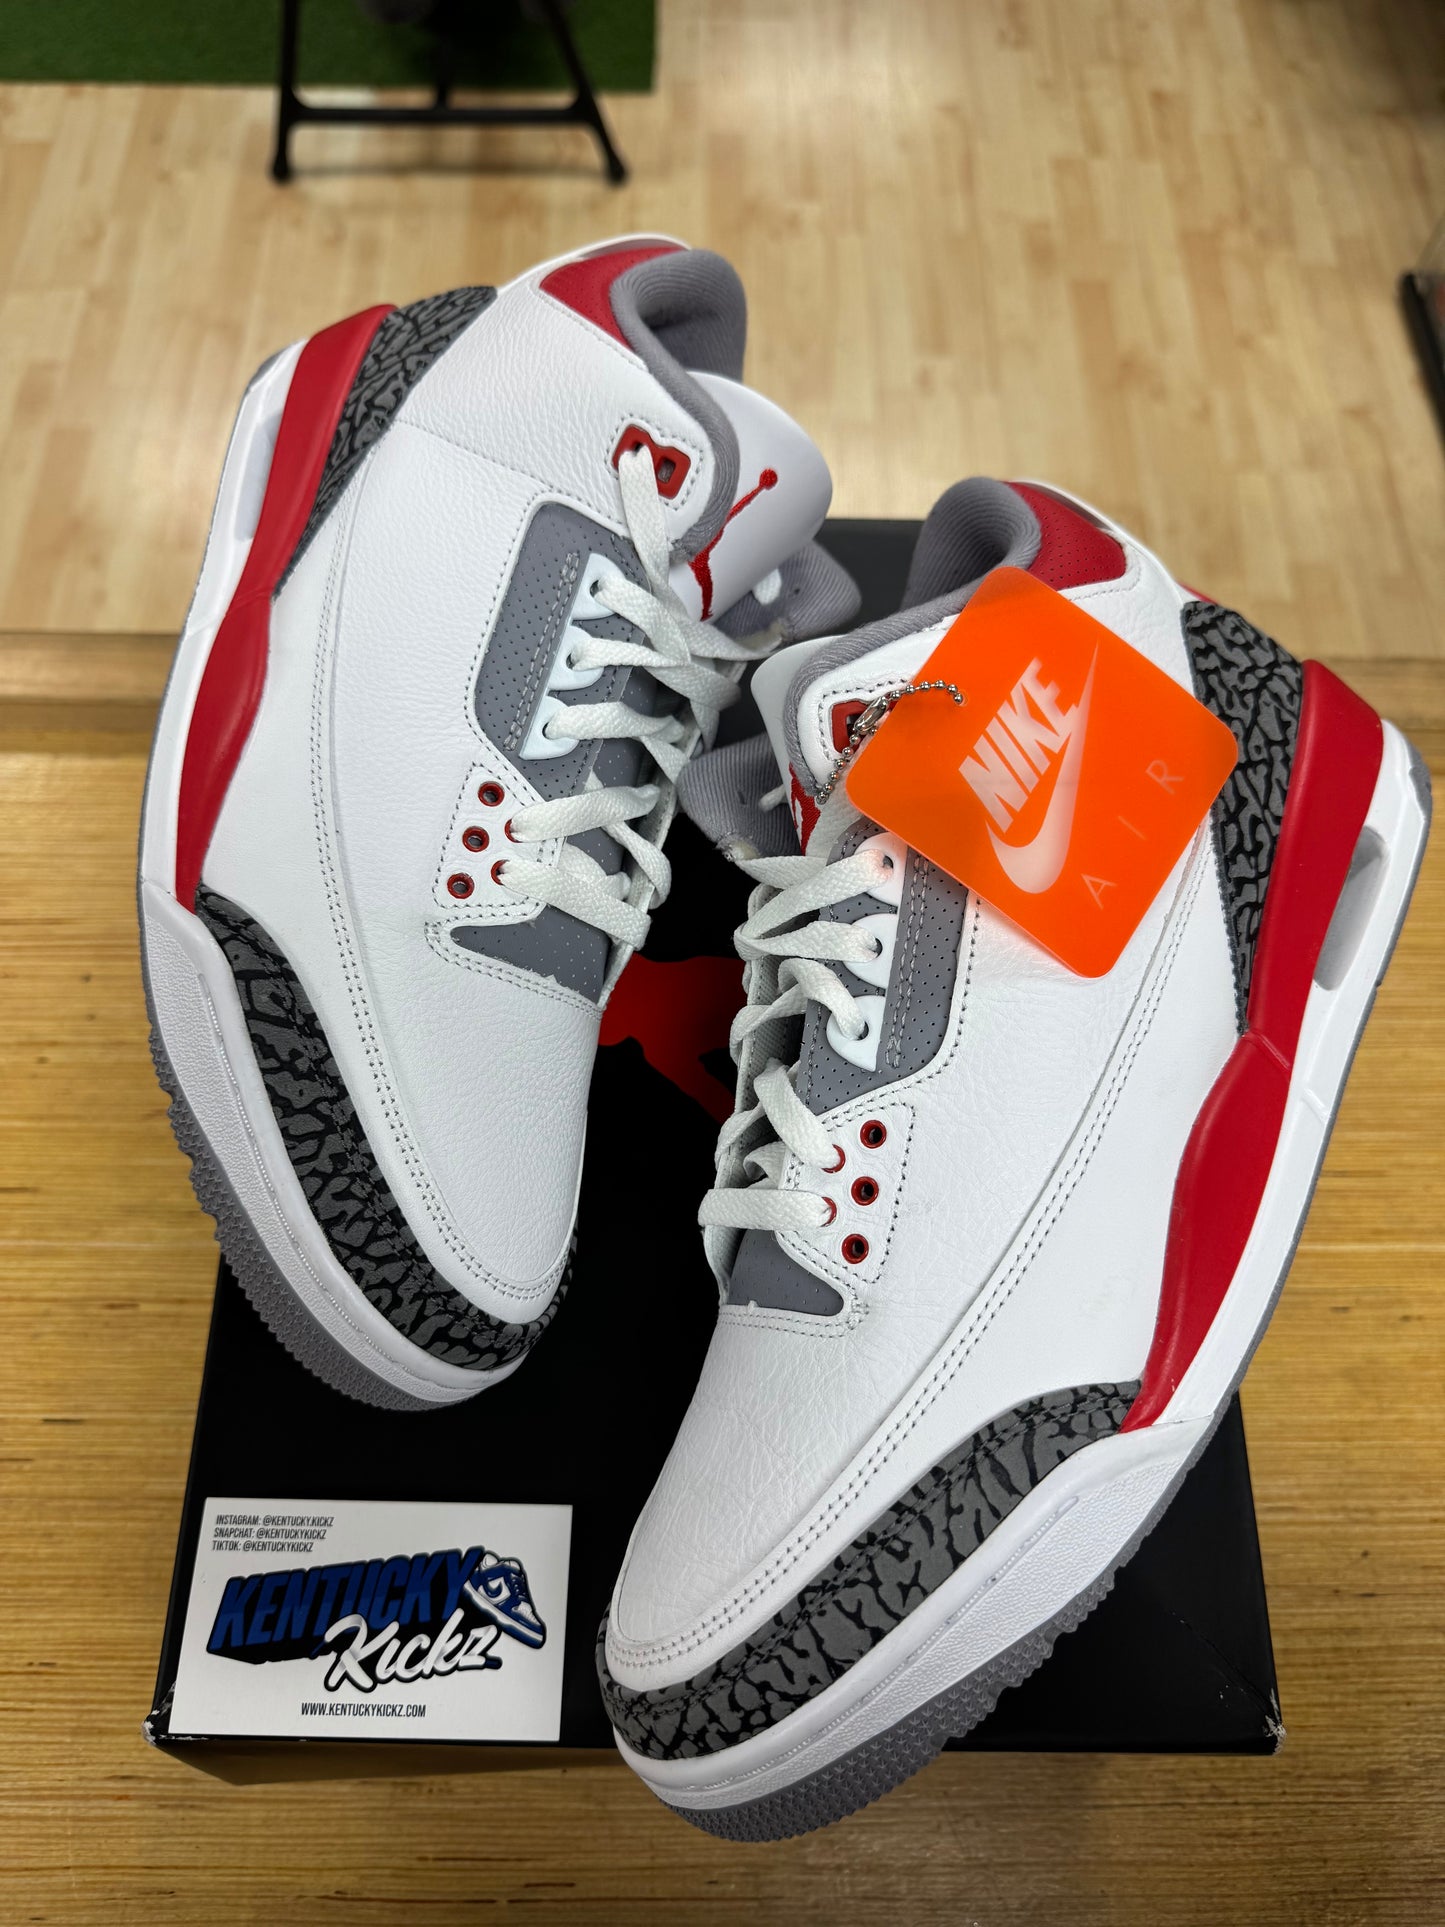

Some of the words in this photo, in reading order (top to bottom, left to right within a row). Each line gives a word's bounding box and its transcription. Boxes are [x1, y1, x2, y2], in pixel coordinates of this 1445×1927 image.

[959, 656, 1079, 833] NIKE
[216, 1514, 262, 1526] INSTAGRAM:
[214, 1527, 255, 1539] SNAPCHAT:
[256, 1528, 327, 1540] @KENTUCKYKICKZ
[212, 1540, 242, 1551] TIKTOK:
[243, 1540, 314, 1553] @KENTUCKYKICKZ
[207, 1546, 485, 1654] KENTUCKY
[324, 1607, 502, 1692] Kickz
[301, 1702, 426, 1718] WWW.KENTUCKYKICKZ.COM
